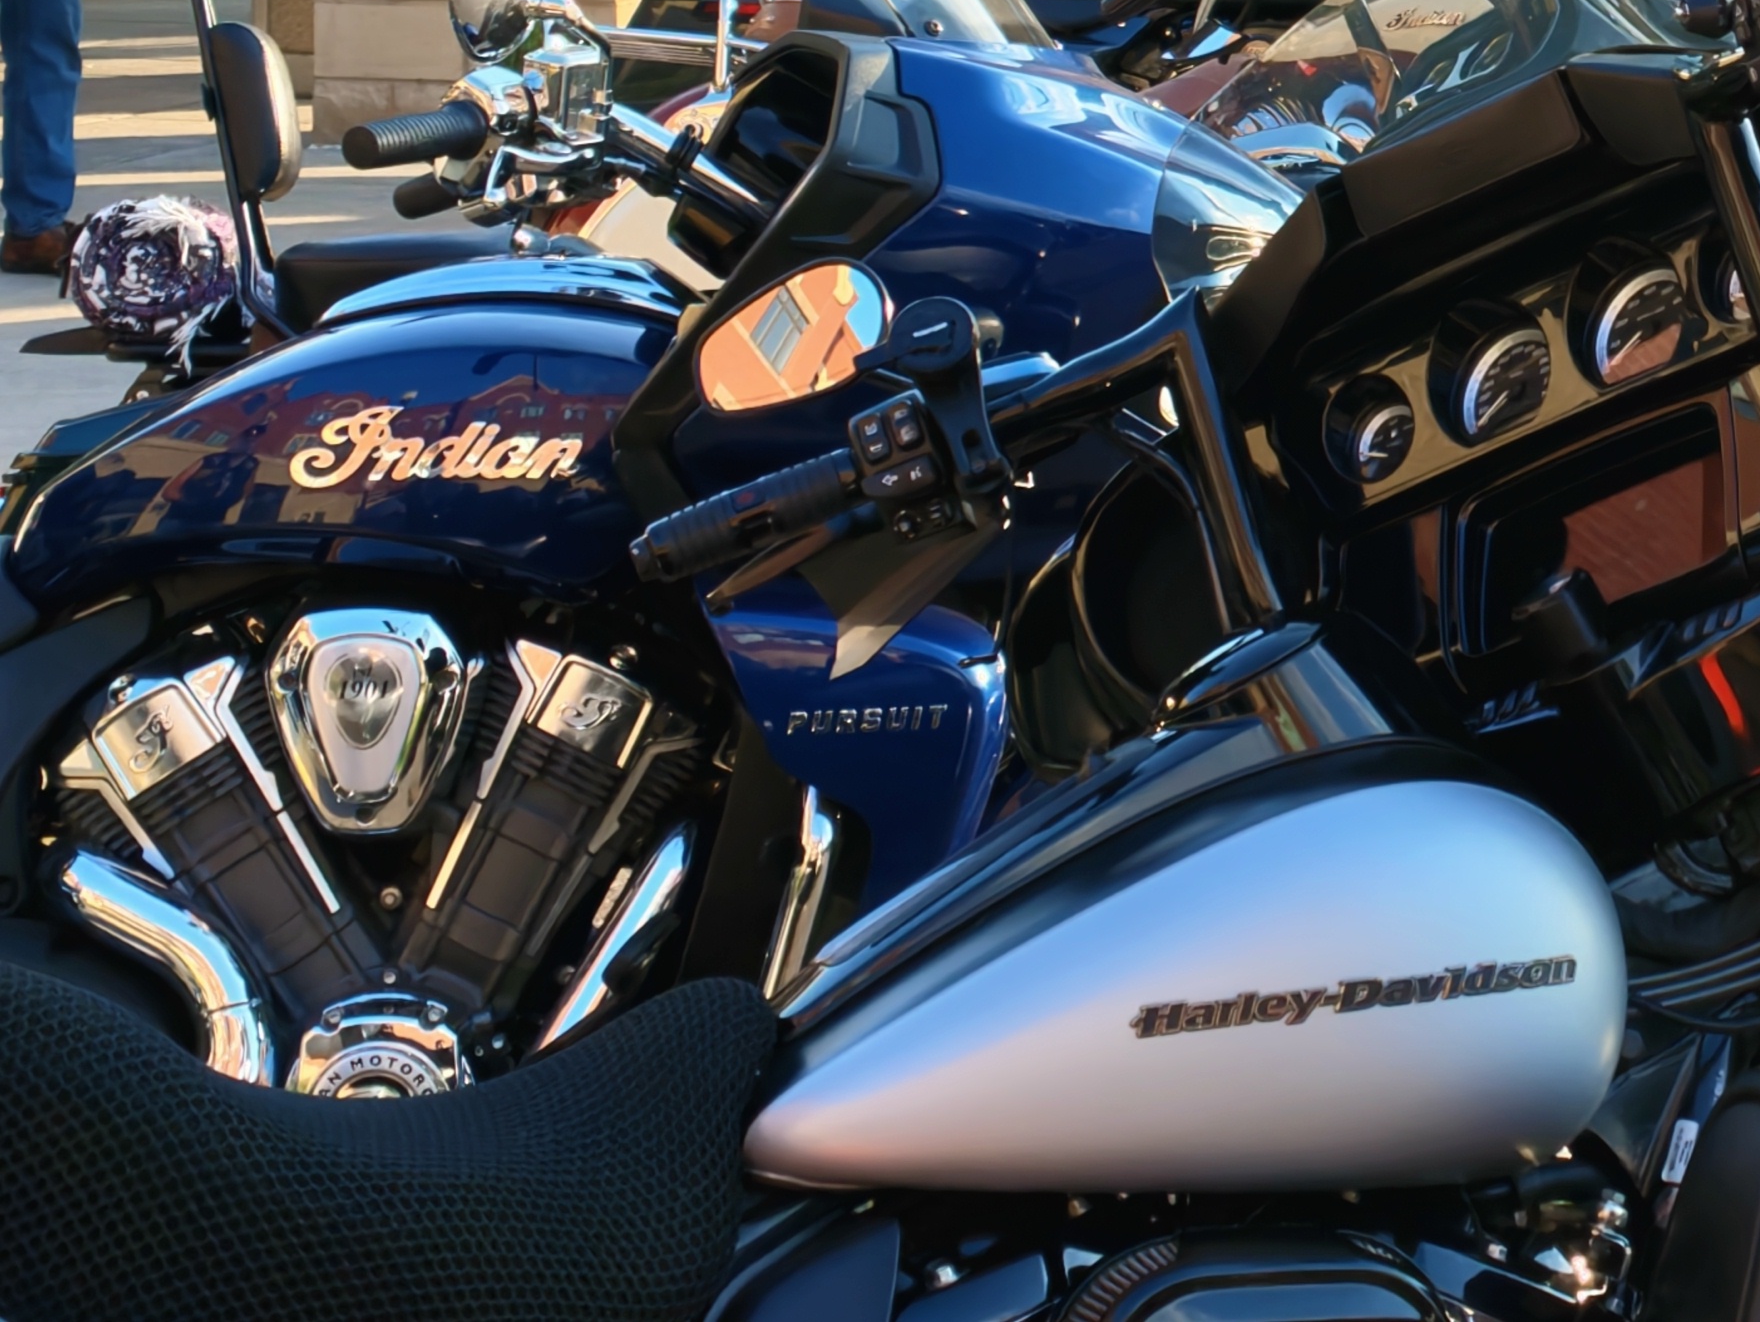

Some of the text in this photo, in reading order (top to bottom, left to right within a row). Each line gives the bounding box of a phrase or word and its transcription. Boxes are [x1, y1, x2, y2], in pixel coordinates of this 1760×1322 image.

[1382, 5, 1467, 31] Indian
[289, 405, 584, 489] Indian
[339, 680, 389, 699] 1901
[786, 704, 948, 735] PURSUIT
[1129, 954, 1578, 1038] Harley-Davidson
